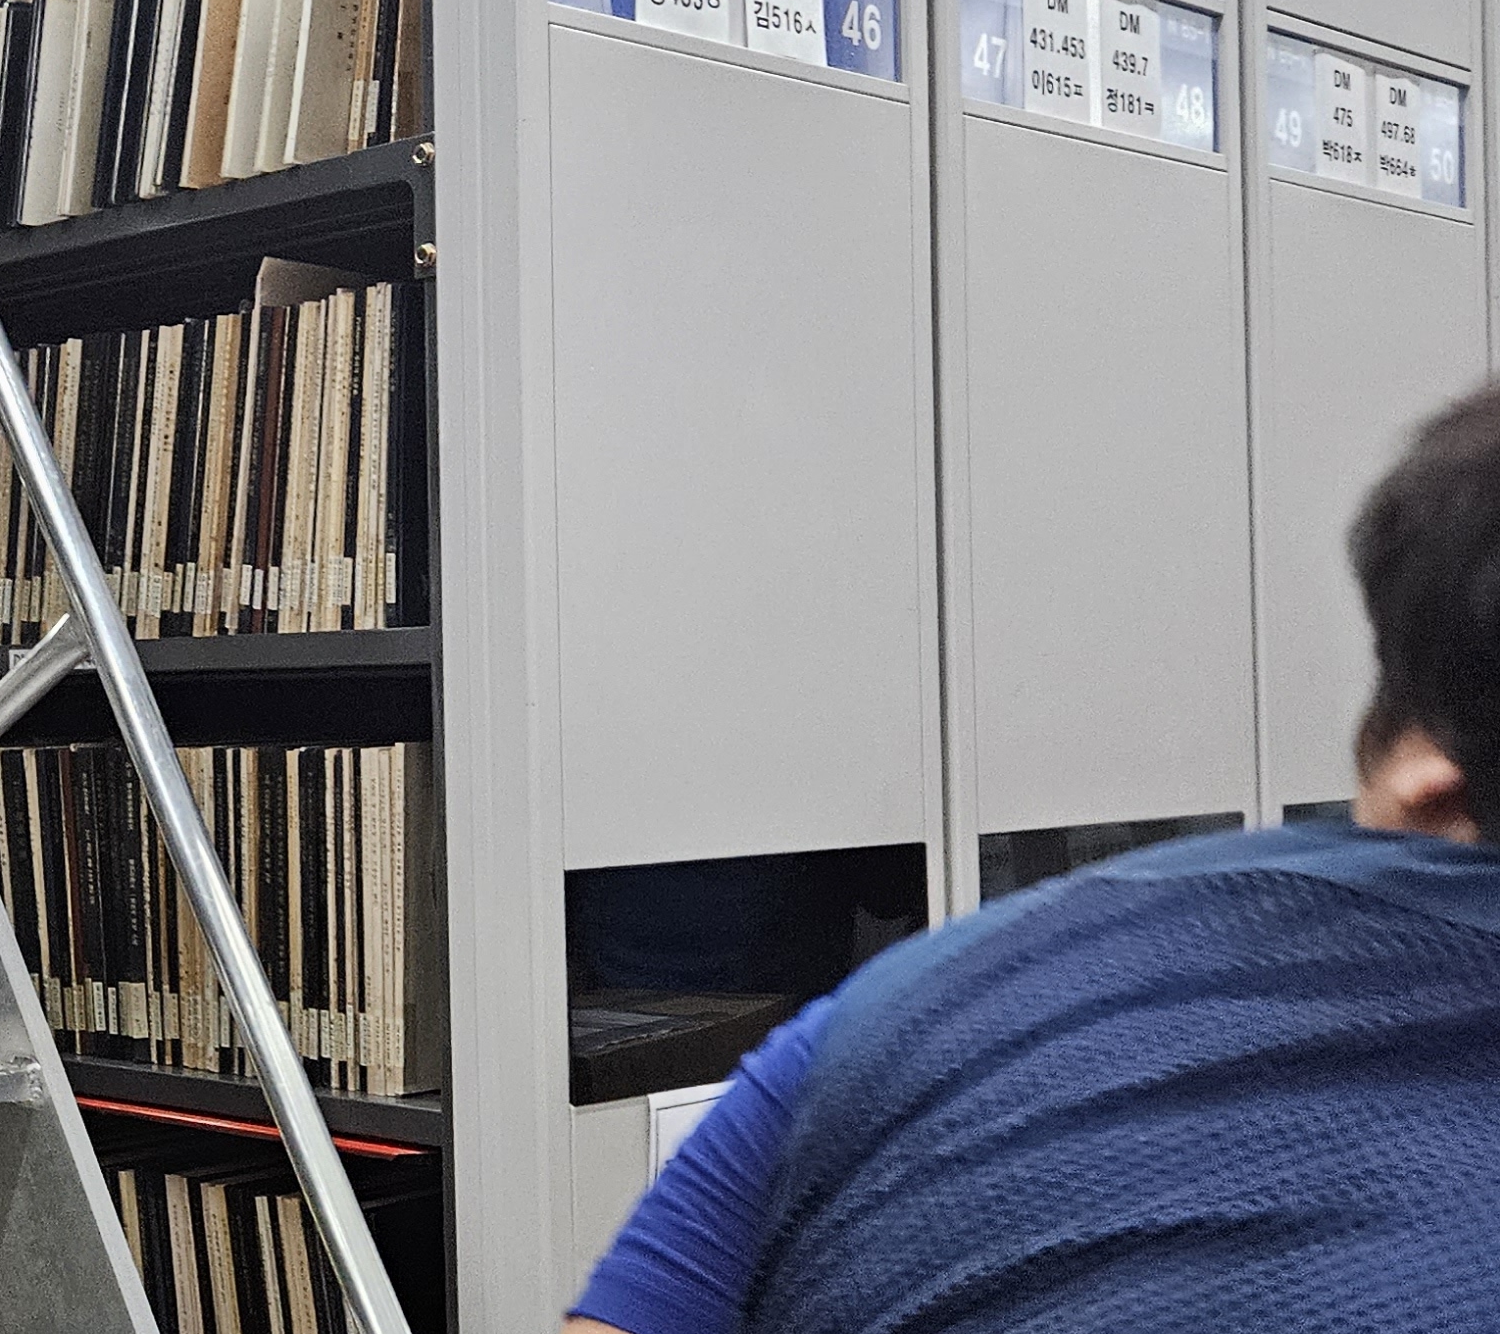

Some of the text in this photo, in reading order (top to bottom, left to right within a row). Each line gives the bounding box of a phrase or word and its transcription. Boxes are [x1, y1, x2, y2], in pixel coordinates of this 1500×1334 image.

[842, 0, 882, 50] 46
[1120, 11, 1140, 35] DM
[973, 32, 1007, 79] 47
[1030, 28, 1086, 60] 431.453
[1112, 50, 1149, 77] 439.7
[1334, 70, 1351, 91] DM
[1175, 83, 1205, 129] 48
[1390, 87, 1407, 107] DM
[1274, 108, 1302, 148] 49
[1333, 106, 1353, 128] 475
[1429, 147, 1454, 185] 50
